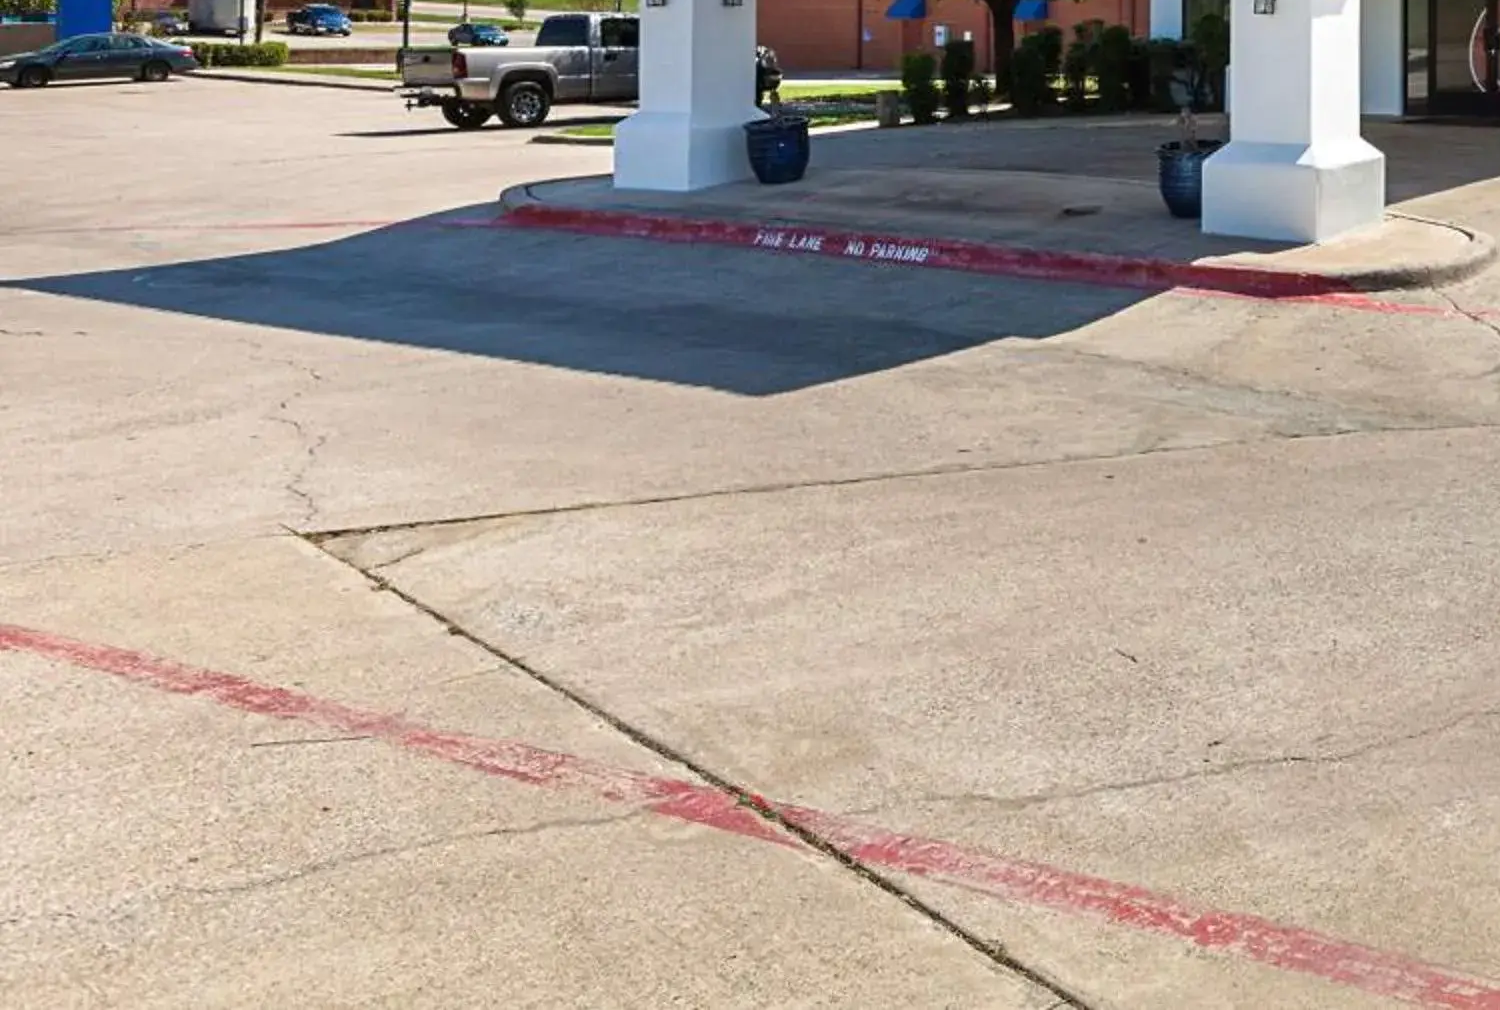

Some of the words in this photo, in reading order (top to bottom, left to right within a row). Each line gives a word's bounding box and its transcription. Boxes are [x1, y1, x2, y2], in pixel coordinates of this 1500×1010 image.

[788, 235, 824, 252] LANE
[843, 240, 864, 257] NO
[868, 242, 930, 262] PARKING
